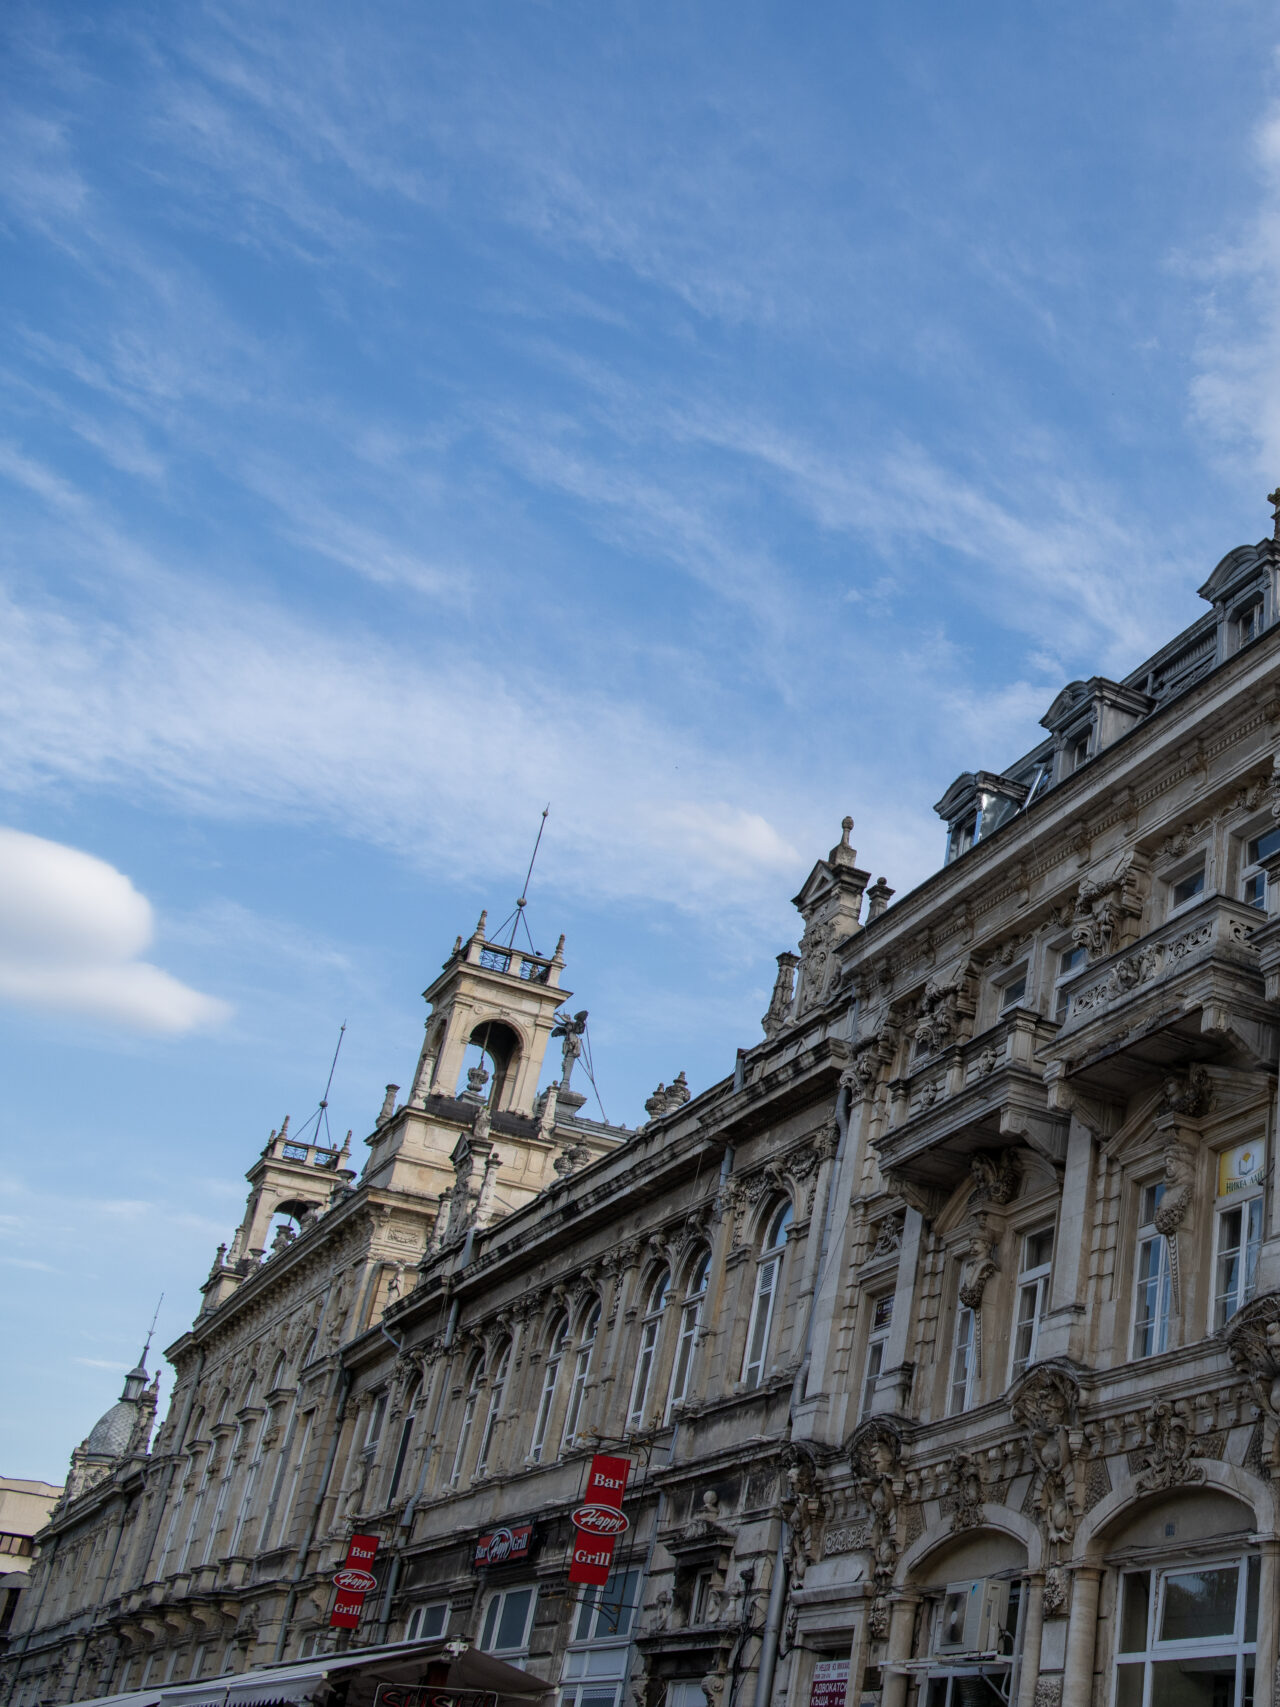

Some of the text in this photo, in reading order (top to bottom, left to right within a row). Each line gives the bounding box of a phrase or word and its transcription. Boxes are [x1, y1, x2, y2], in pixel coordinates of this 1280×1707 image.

[593, 1473, 624, 1489] Bar
[579, 1508, 624, 1532] Happy
[351, 1546, 374, 1559] Bar
[474, 1545, 488, 1560] Bar
[512, 1532, 529, 1551] Grill
[575, 1549, 611, 1567] Grill
[339, 1572, 374, 1590] Happy
[334, 1603, 361, 1616] Grill
